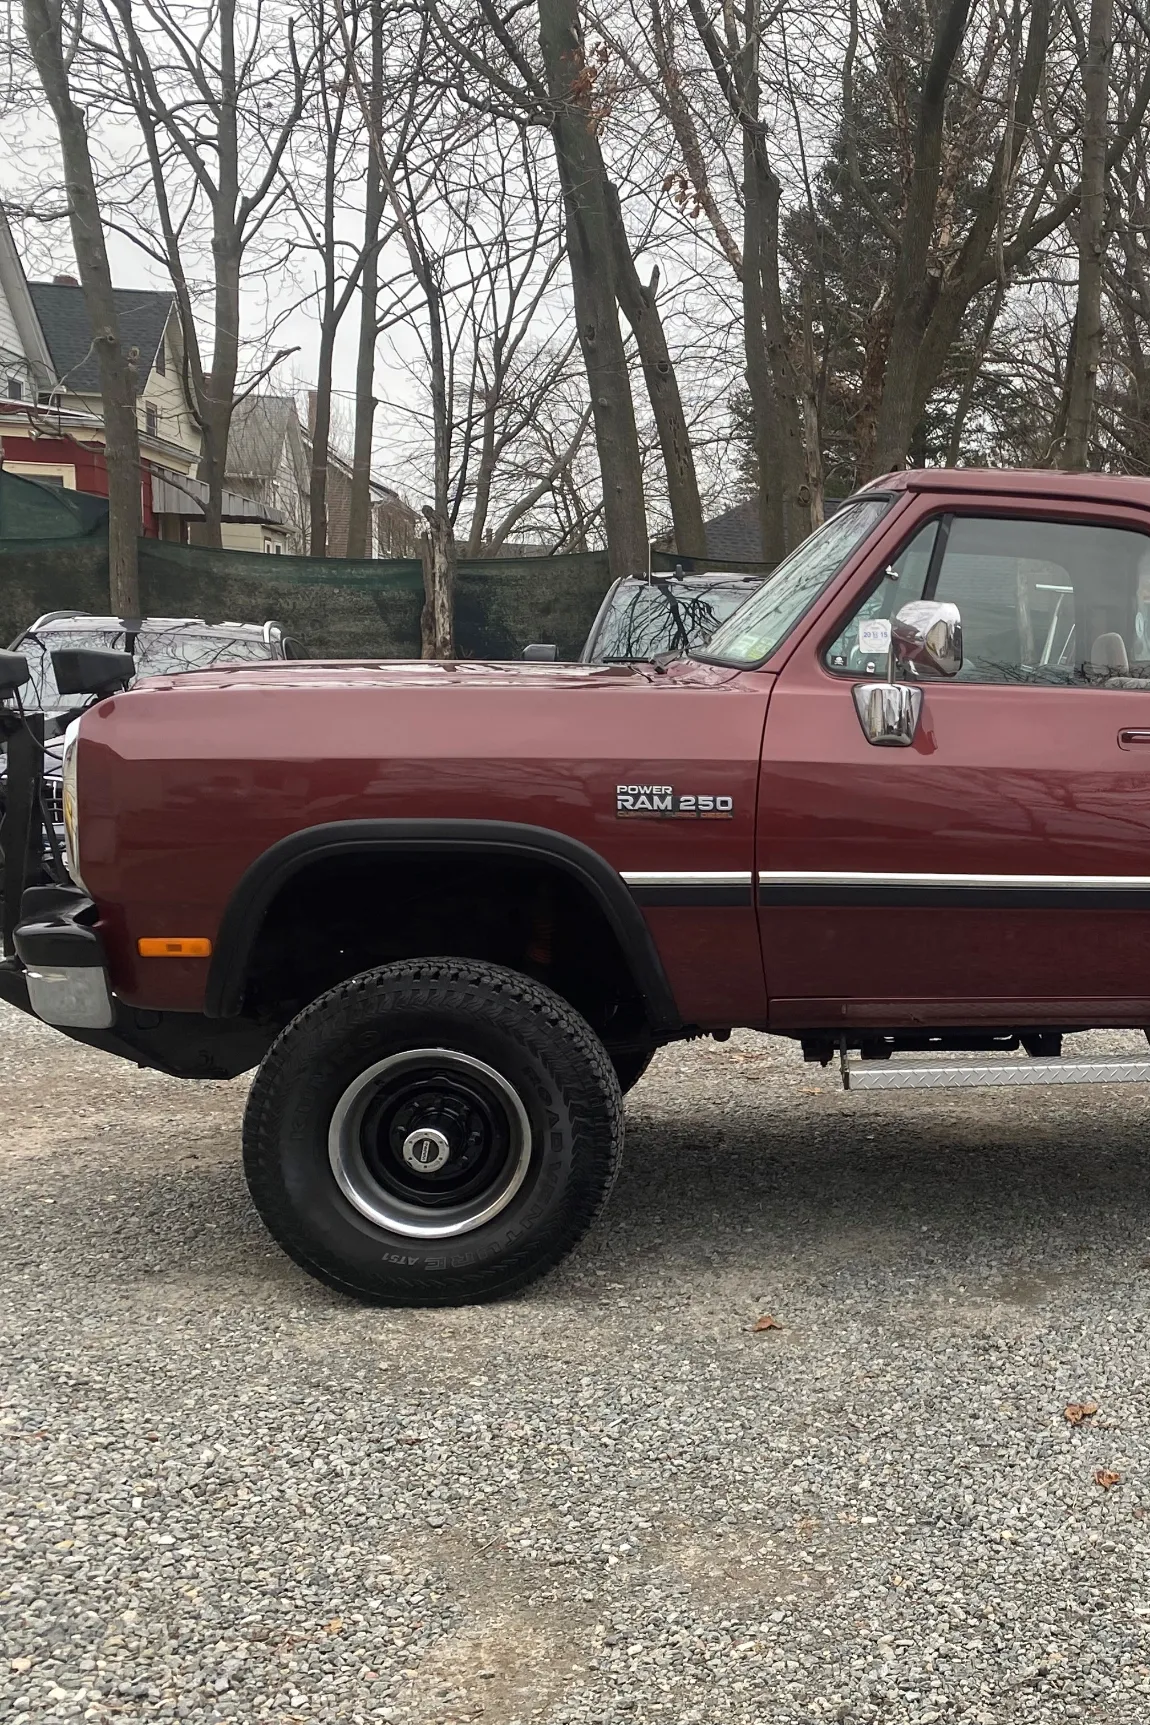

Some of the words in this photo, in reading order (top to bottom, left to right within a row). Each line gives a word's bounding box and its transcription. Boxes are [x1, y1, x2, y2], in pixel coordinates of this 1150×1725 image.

[616, 785, 673, 794] POWER
[617, 795, 673, 810] RAM
[679, 796, 733, 811] 250
[381, 1252, 420, 1267] AT51
